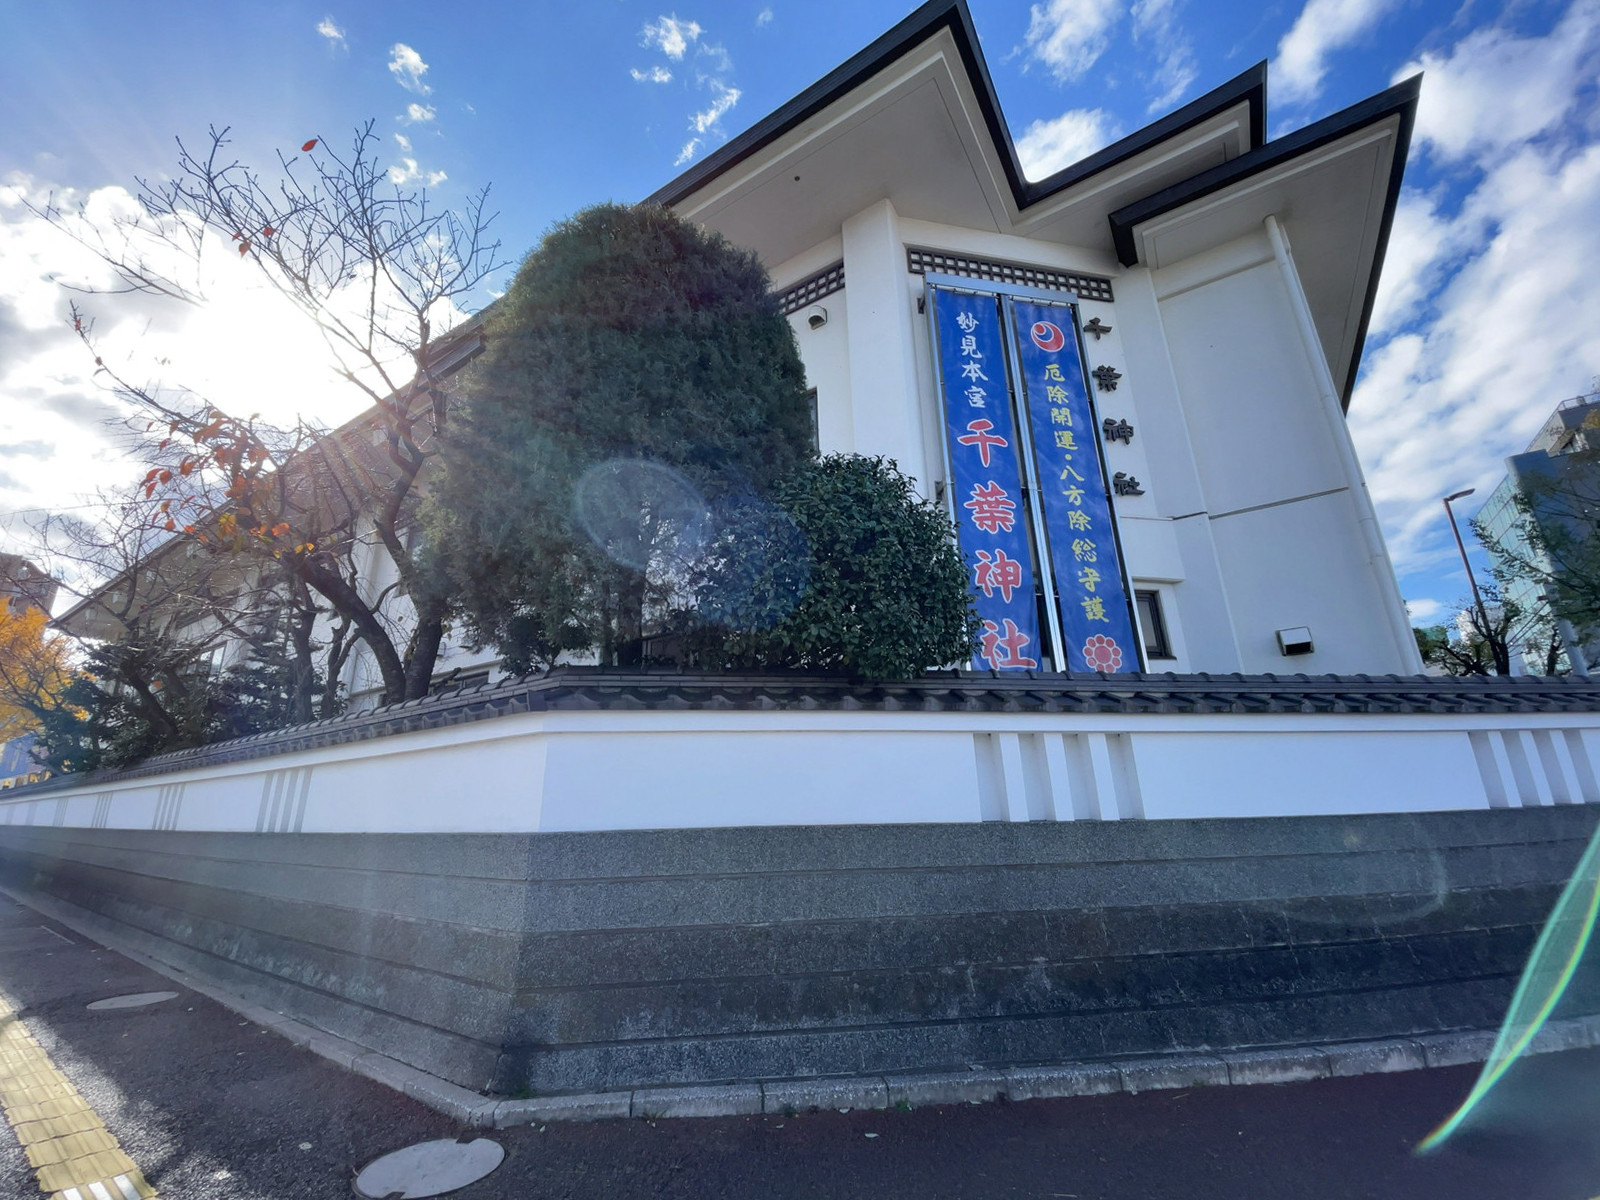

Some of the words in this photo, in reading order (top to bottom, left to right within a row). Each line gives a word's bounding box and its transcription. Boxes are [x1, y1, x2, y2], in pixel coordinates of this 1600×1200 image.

[955, 311, 988, 408] 妙見本宮
[1083, 316, 1146, 496] 千葉神社
[957, 418, 1037, 670] 千葉神社
